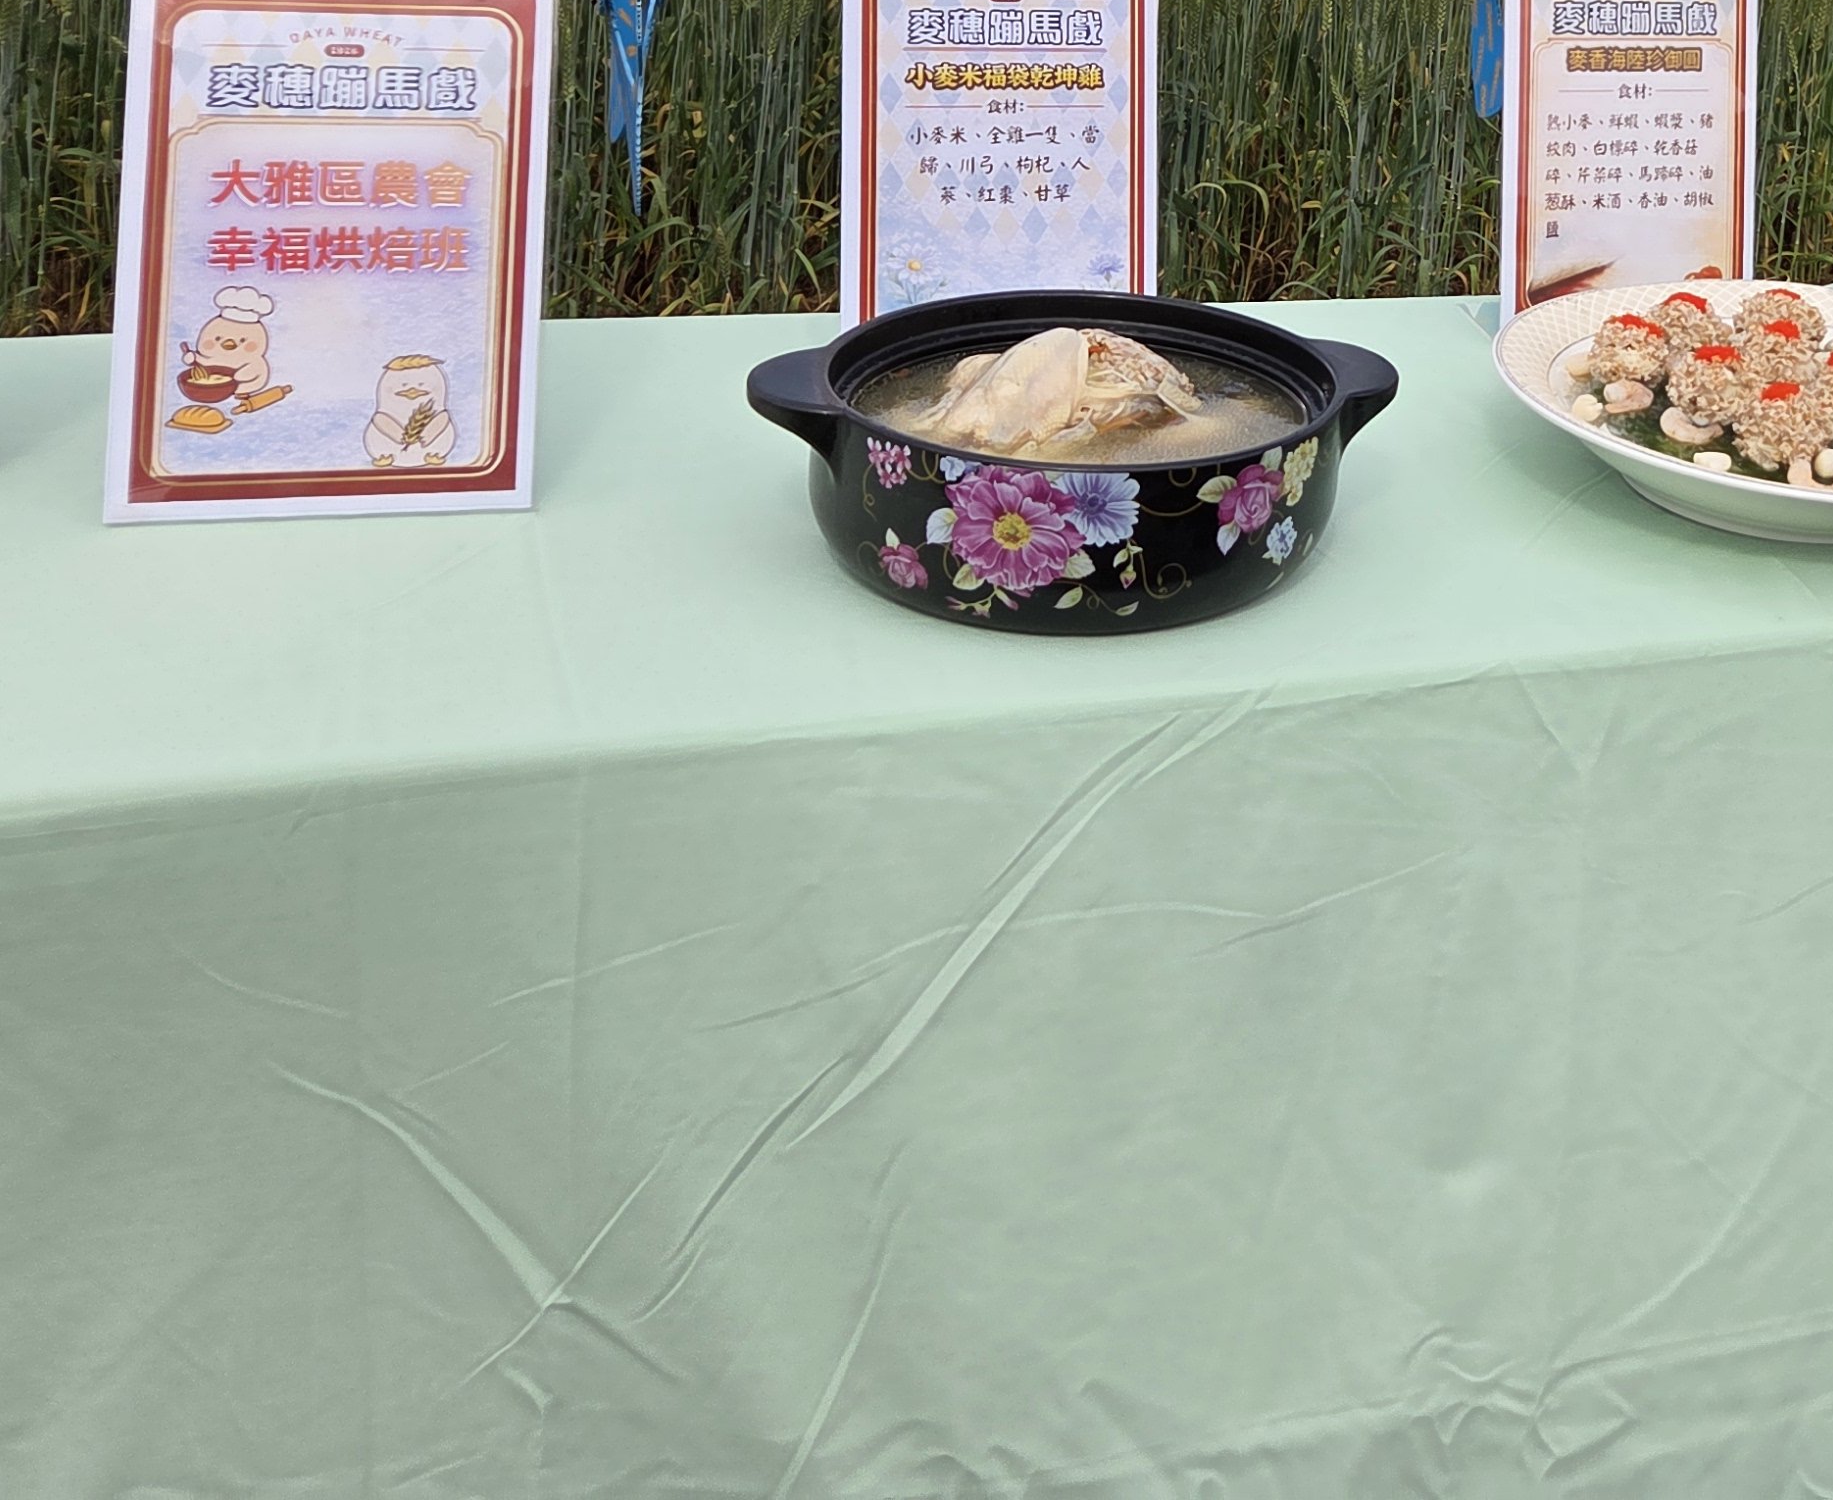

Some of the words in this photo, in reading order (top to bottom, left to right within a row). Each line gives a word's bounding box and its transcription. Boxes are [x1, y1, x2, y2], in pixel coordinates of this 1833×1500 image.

[289, 27, 336, 44] DAYA
[343, 26, 406, 48] WHEAT
[907, 7, 1103, 46] 麥穗蹦馬戲
[1552, 0, 1717, 37] 麥穗蹦馬戲
[206, 63, 477, 111] 麥穗蹦馬戲
[904, 61, 1105, 91] 小麥米福袋乾坤雞
[207, 158, 472, 208] 大雅區農會
[206, 225, 472, 274] 幸福烘焙班
